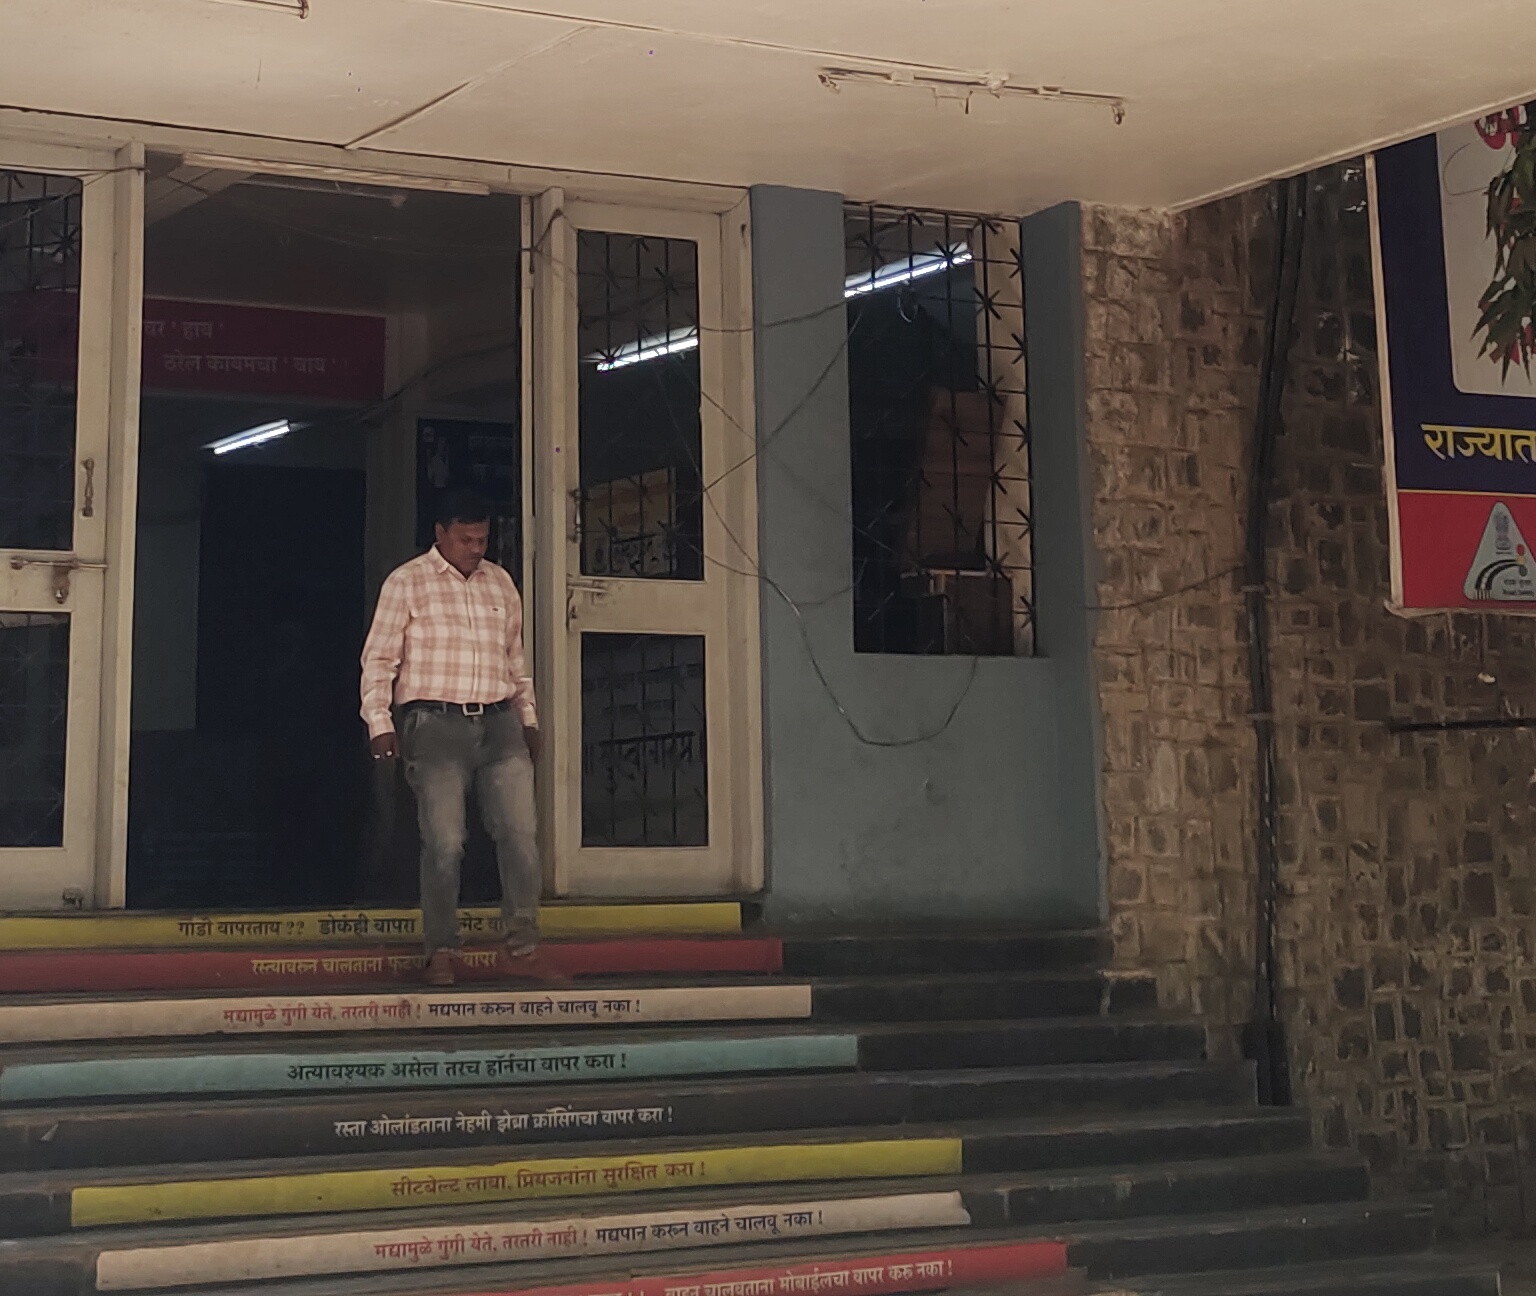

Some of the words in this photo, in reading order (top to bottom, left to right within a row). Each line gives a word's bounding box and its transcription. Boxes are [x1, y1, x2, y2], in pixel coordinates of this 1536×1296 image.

[429, 1003, 475, 1017] मद्यपान
[520, 996, 554, 1017] वाहने
[287, 1063, 386, 1082] अत्यावश्यक
[392, 1056, 439, 1078] असेल
[444, 1060, 481, 1078] तरच
[540, 1055, 580, 1073] वापर
[584, 1053, 616, 1070] करा
[334, 1120, 366, 1137] रस्ता
[370, 1113, 453, 1136] ओलांडताना
[455, 1109, 492, 1134] नेहमी
[601, 1108, 635, 1126] वापर
[637, 1107, 664, 1124] करा
[390, 1175, 462, 1196] सीटबेल्ट
[664, 1161, 694, 1177] करा
[596, 1225, 647, 1244] मद्यपान
[693, 1213, 731, 1237] वाहने
[734, 1214, 780, 1236] चालवू
[782, 1211, 814, 1228] नका
[852, 1266, 884, 1285] वापर
[915, 1259, 946, 1279] नका
